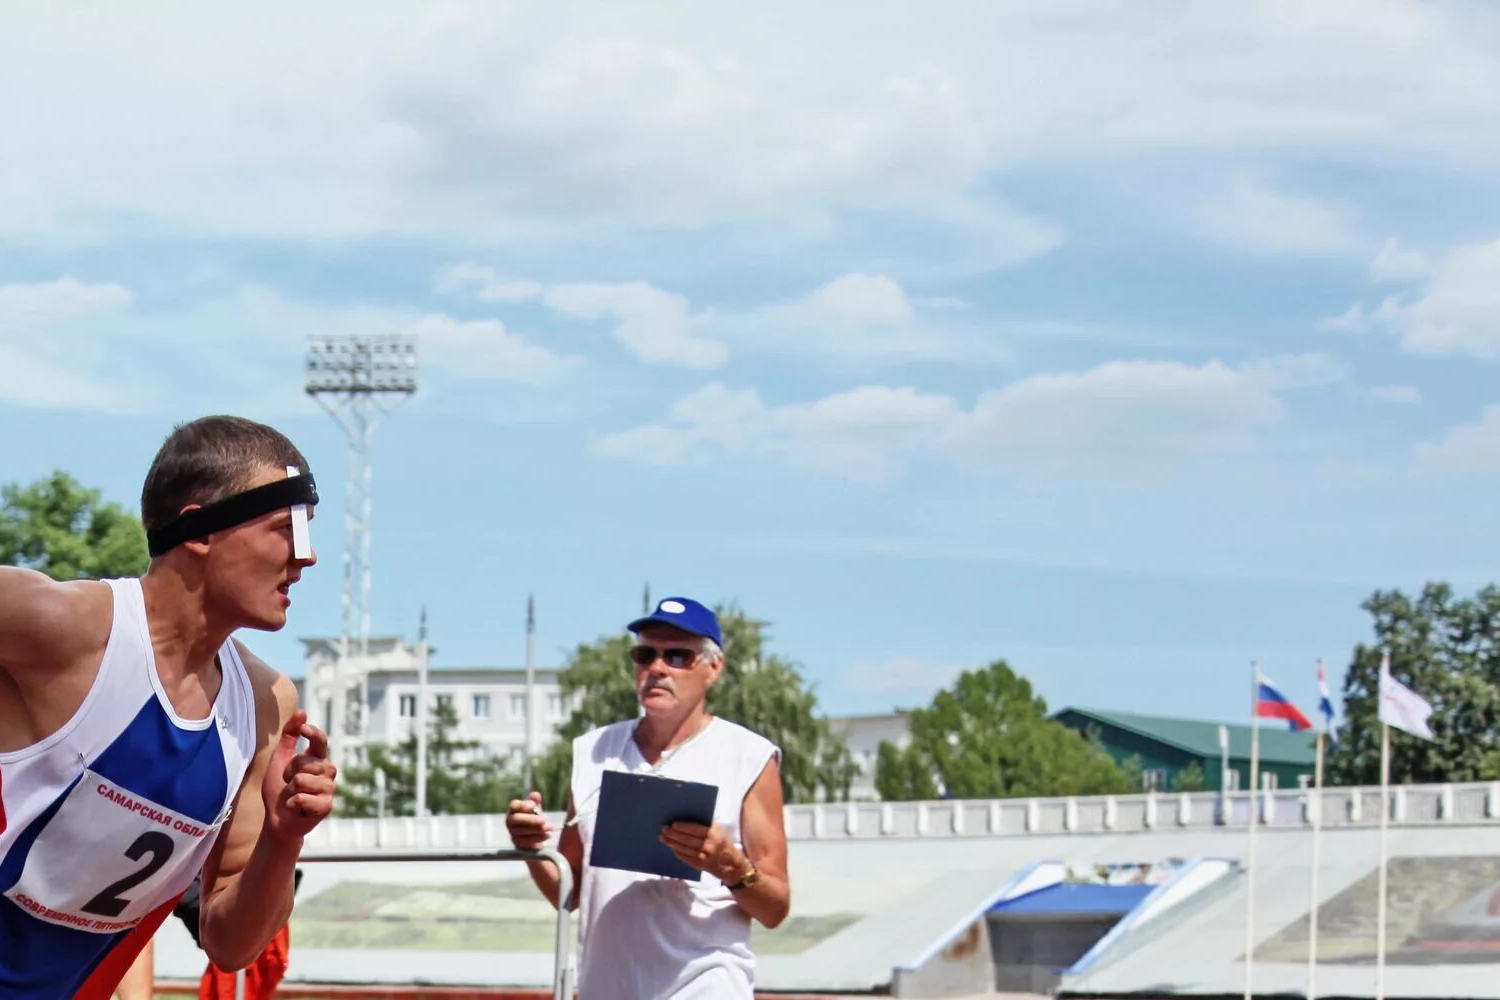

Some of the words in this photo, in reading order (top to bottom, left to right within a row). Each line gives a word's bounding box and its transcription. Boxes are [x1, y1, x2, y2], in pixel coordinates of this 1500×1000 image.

[96, 783, 173, 827] САМАРСКАЯ
[80, 831, 175, 917] 2
[15, 894, 92, 927] СОВРЕМЕННОЕ
